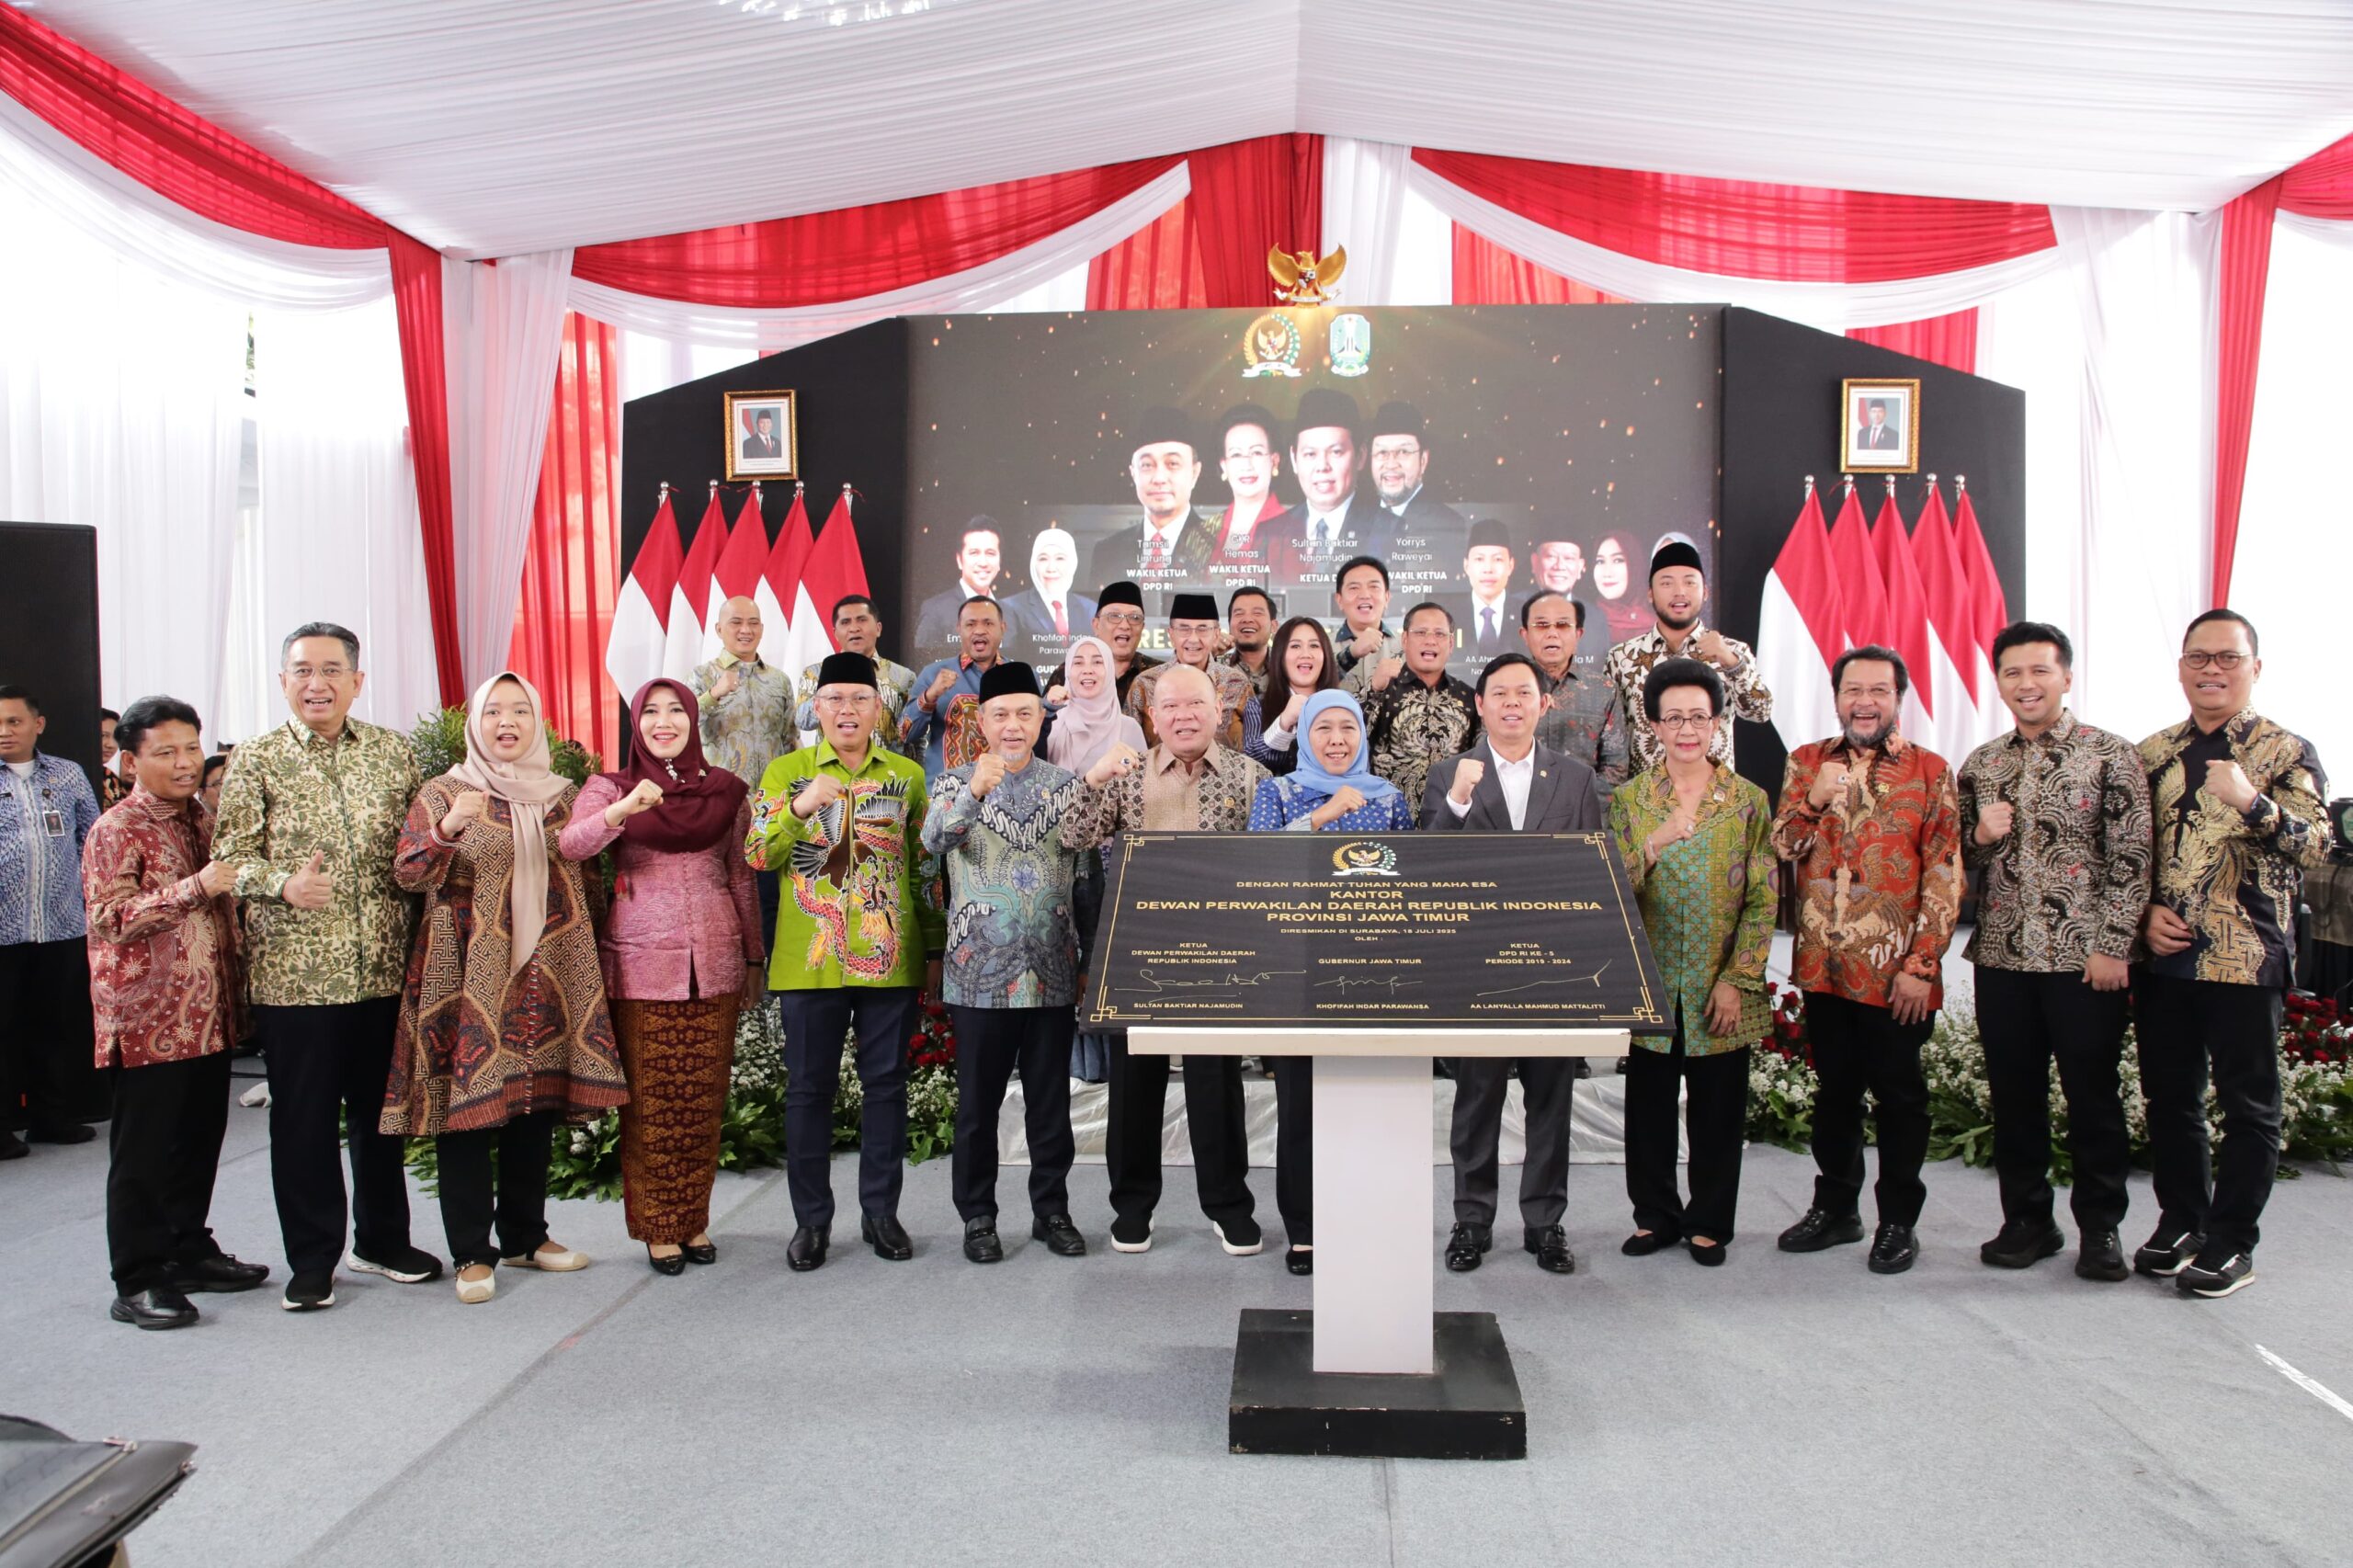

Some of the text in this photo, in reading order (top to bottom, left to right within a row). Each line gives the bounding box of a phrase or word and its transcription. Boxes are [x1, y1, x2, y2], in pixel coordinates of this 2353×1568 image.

[1137, 540, 1170, 550] Tamsil
[1291, 538, 1323, 548] Sultan
[1395, 537, 1427, 549] Yorrys
[1224, 550, 1259, 559] Hemas
[1299, 553, 1354, 564] Najamudin
[1126, 569, 1188, 578] WAKIL KETUA
[1209, 564, 1271, 574] WAKIL KETUA
[1300, 574, 1330, 583] KETUA
[1416, 571, 1448, 581] KETUA
[1142, 582, 1173, 592] DPD RI
[1225, 578, 1256, 587] DPD RI
[1402, 585, 1433, 594] DPD RI
[1465, 655, 1477, 664] AA
[1330, 890, 1404, 900] KANTOR
[1136, 901, 1603, 911] DEWAN PERWAKILAN DAERAH REPUBLIK INDONESIA
[1267, 913, 1471, 922] PROVINSI JAWA TIMUR
